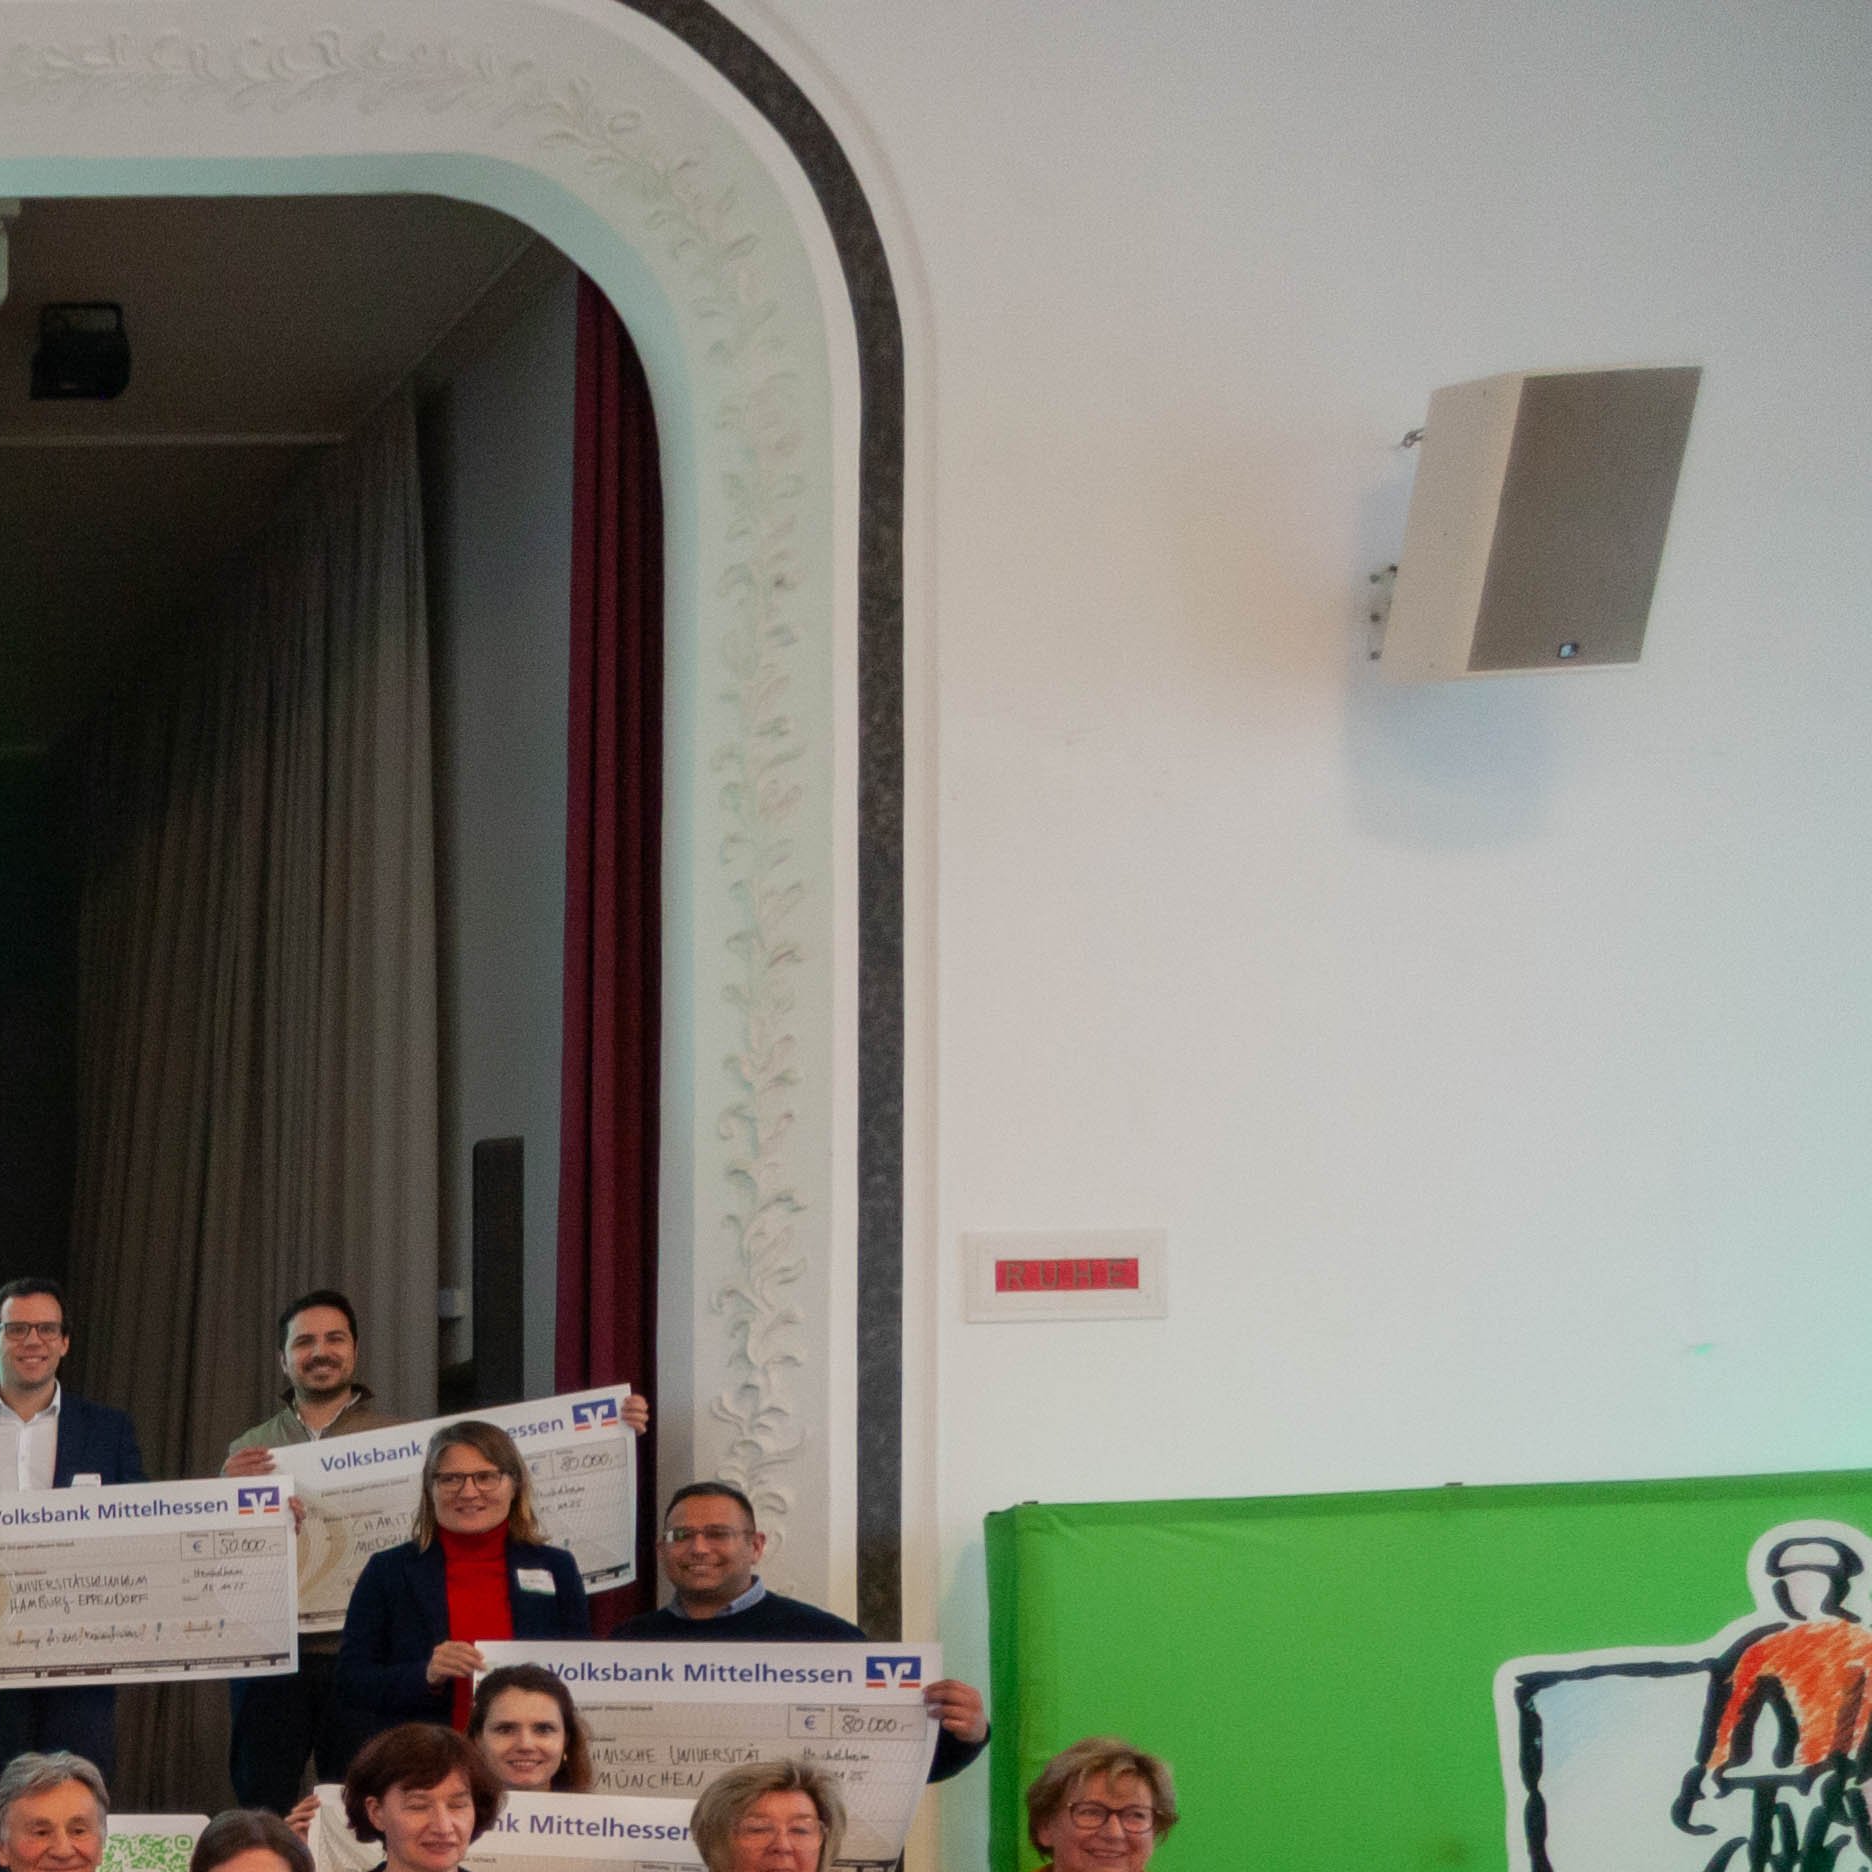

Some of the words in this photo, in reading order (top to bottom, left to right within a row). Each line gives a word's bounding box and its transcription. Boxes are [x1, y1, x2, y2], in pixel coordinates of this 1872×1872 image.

[1007, 1260, 1130, 1289] RUHE
[320, 1441, 423, 1472] Volksbank
[96, 1498, 229, 1519] Mittelhessen
[192, 1541, 202, 1554] €
[548, 1661, 674, 1684] Volksbank
[683, 1662, 853, 1685] Mittelhessen
[804, 1714, 817, 1731] €
[594, 1768, 706, 1789] MÜNCHEN
